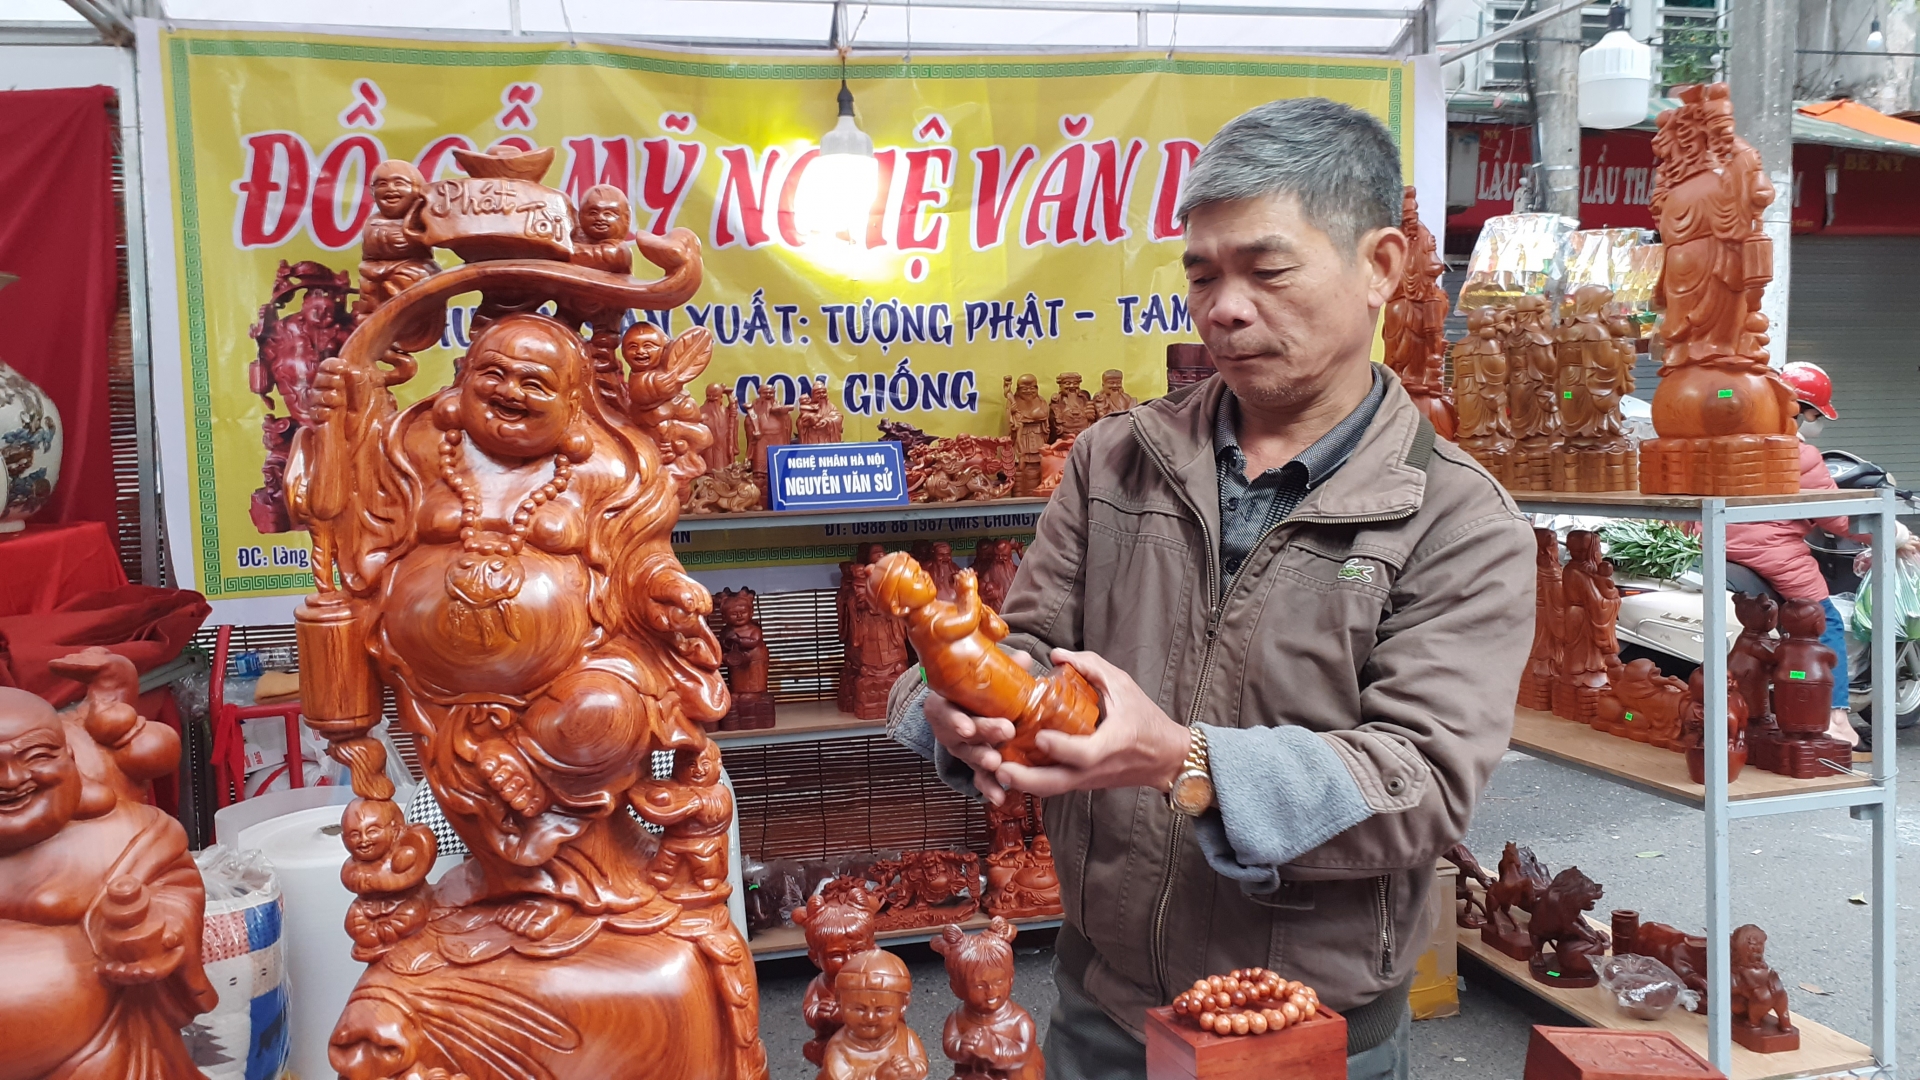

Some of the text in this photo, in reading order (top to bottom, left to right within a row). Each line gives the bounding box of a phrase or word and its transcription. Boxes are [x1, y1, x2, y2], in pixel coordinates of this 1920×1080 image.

[239, 82, 380, 247] ĐỒ
[565, 113, 700, 243] MỸ
[974, 116, 1143, 249] VĂN
[430, 180, 518, 219] Phát
[685, 288, 809, 345] XUẤT:
[821, 297, 951, 355] TƯỢNG
[965, 292, 1064, 348] PHẬT
[843, 358, 977, 415] GIỐNG
[787, 451, 886, 471] NGHỆ NHÂN HÀ NỘI
[784, 467, 894, 497] NGUYỄN VĂN SỬ
[237, 546, 310, 569] ĐC: làng
